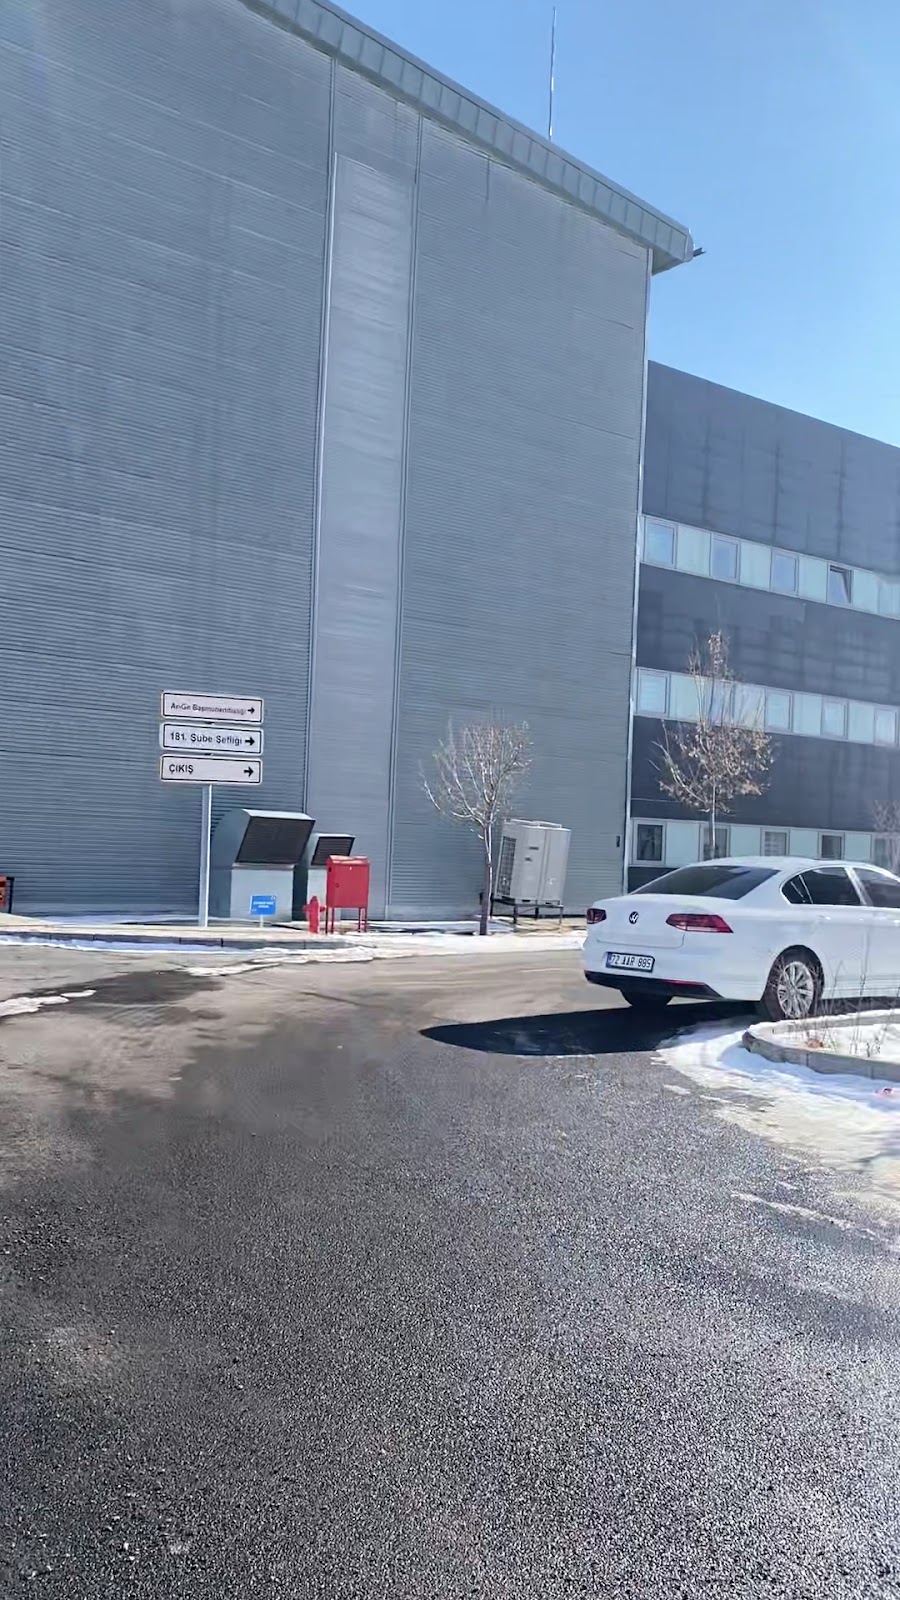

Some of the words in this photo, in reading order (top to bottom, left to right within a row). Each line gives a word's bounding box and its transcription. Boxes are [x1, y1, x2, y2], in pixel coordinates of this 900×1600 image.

[190, 733, 213, 743] Şube
[168, 763, 194, 775] ÇIKIŞ
[611, 954, 620, 965] 72
